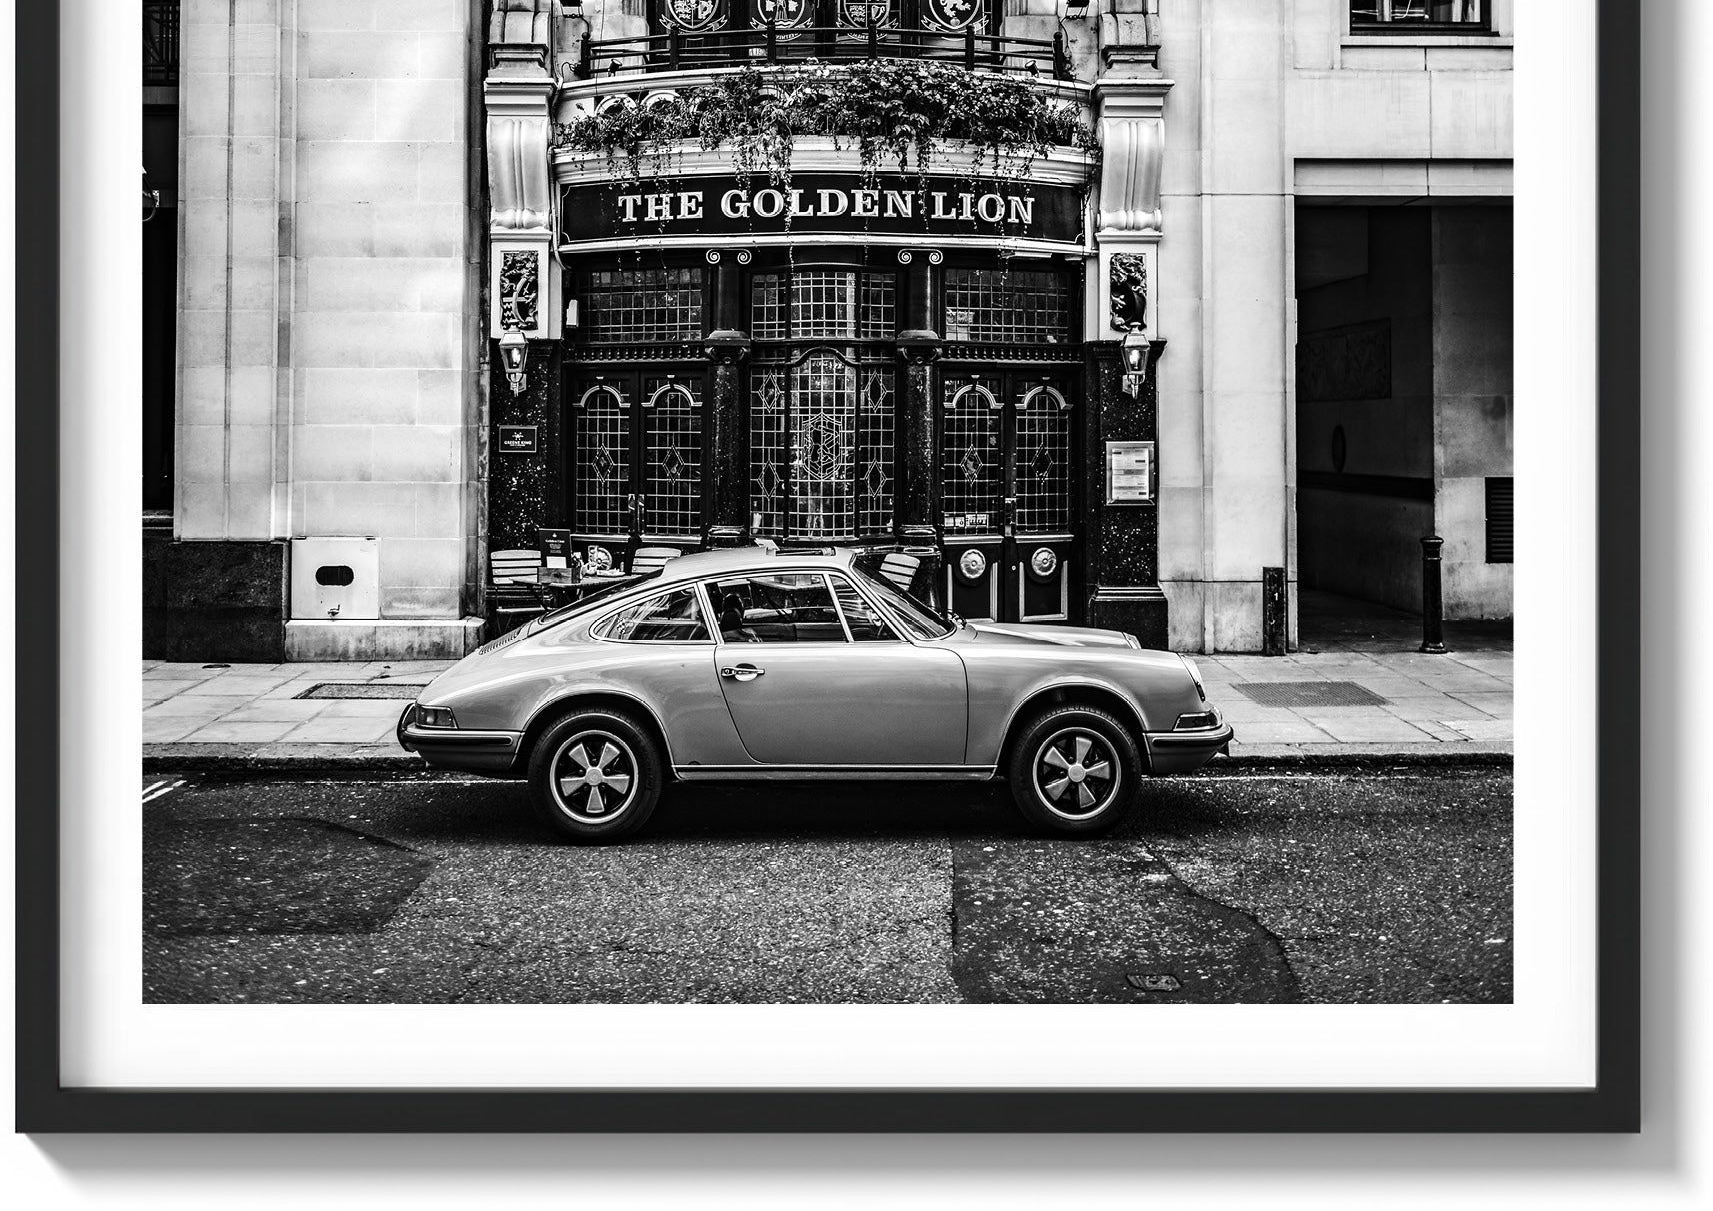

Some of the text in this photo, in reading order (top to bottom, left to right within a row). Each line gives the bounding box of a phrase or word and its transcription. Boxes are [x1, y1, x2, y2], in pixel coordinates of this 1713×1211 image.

[617, 188, 1036, 225] THE GOLDEN LION
